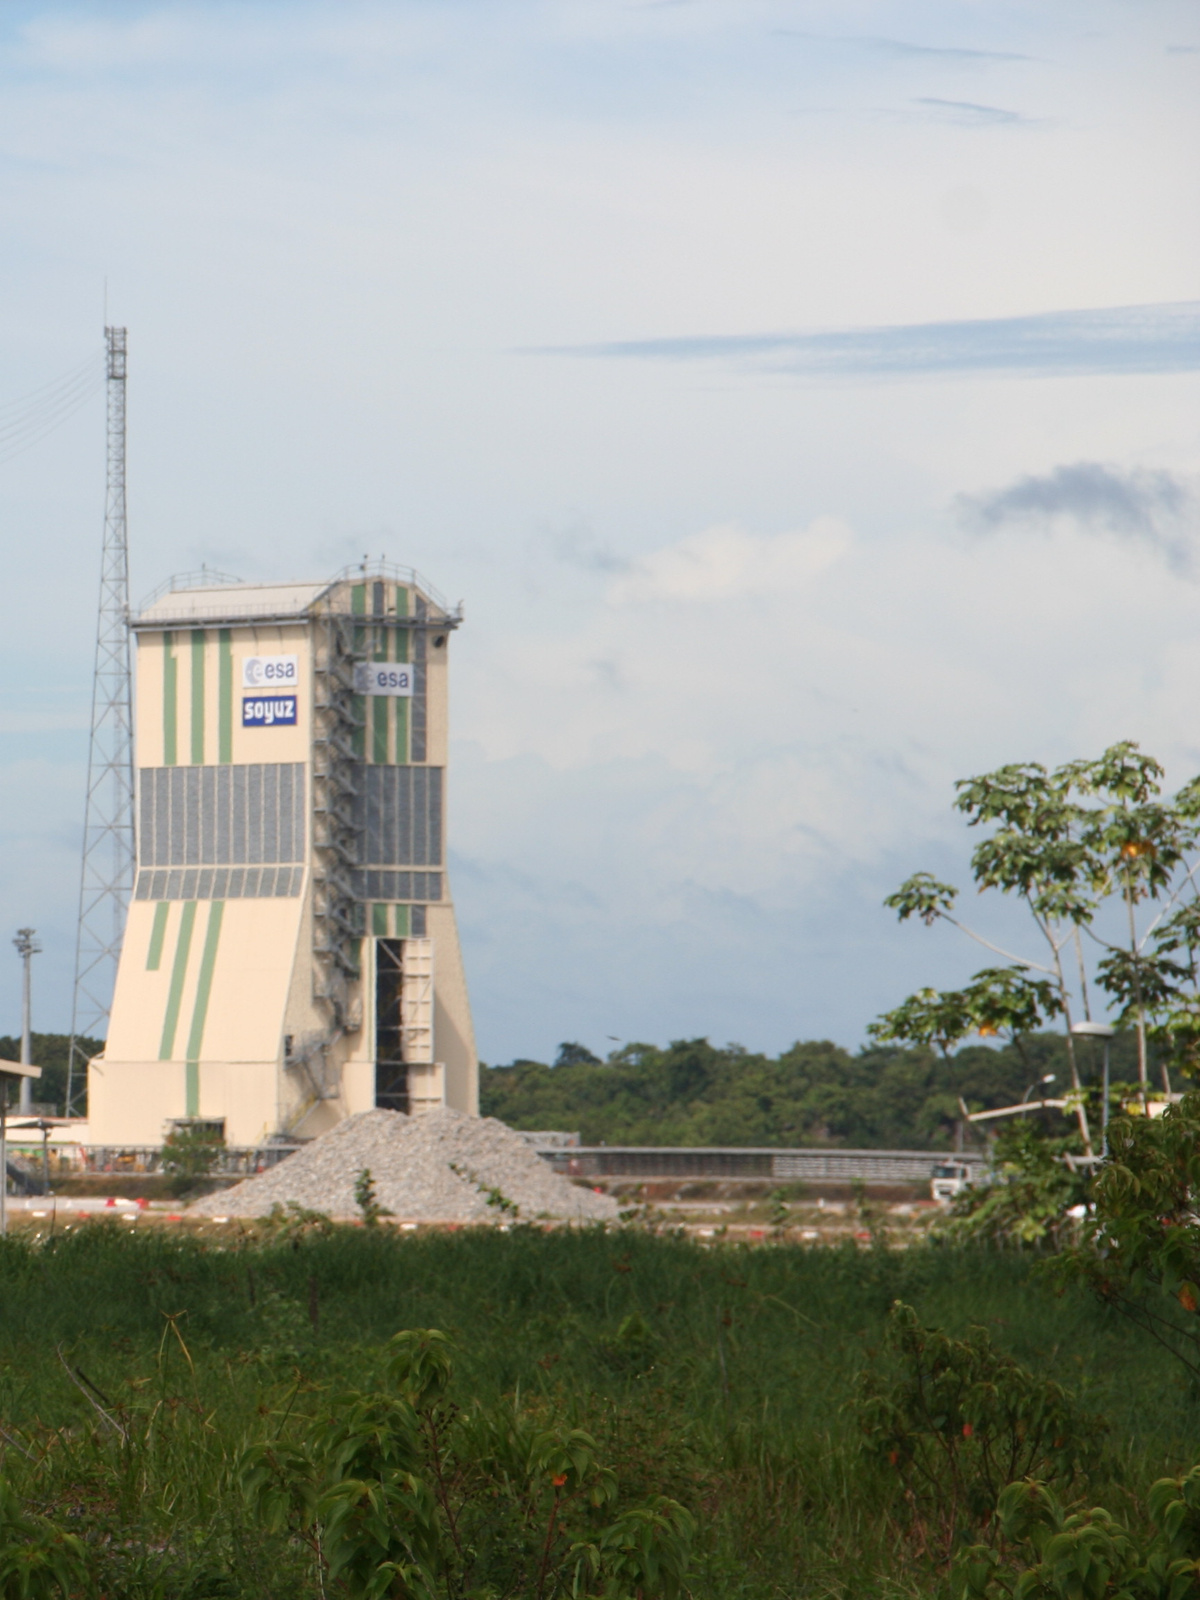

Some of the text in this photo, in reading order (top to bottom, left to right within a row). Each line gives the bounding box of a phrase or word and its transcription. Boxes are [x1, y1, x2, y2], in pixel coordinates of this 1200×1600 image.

[264, 662, 295, 679] esa
[377, 671, 409, 688] esa
[244, 700, 295, 724] soyuz
